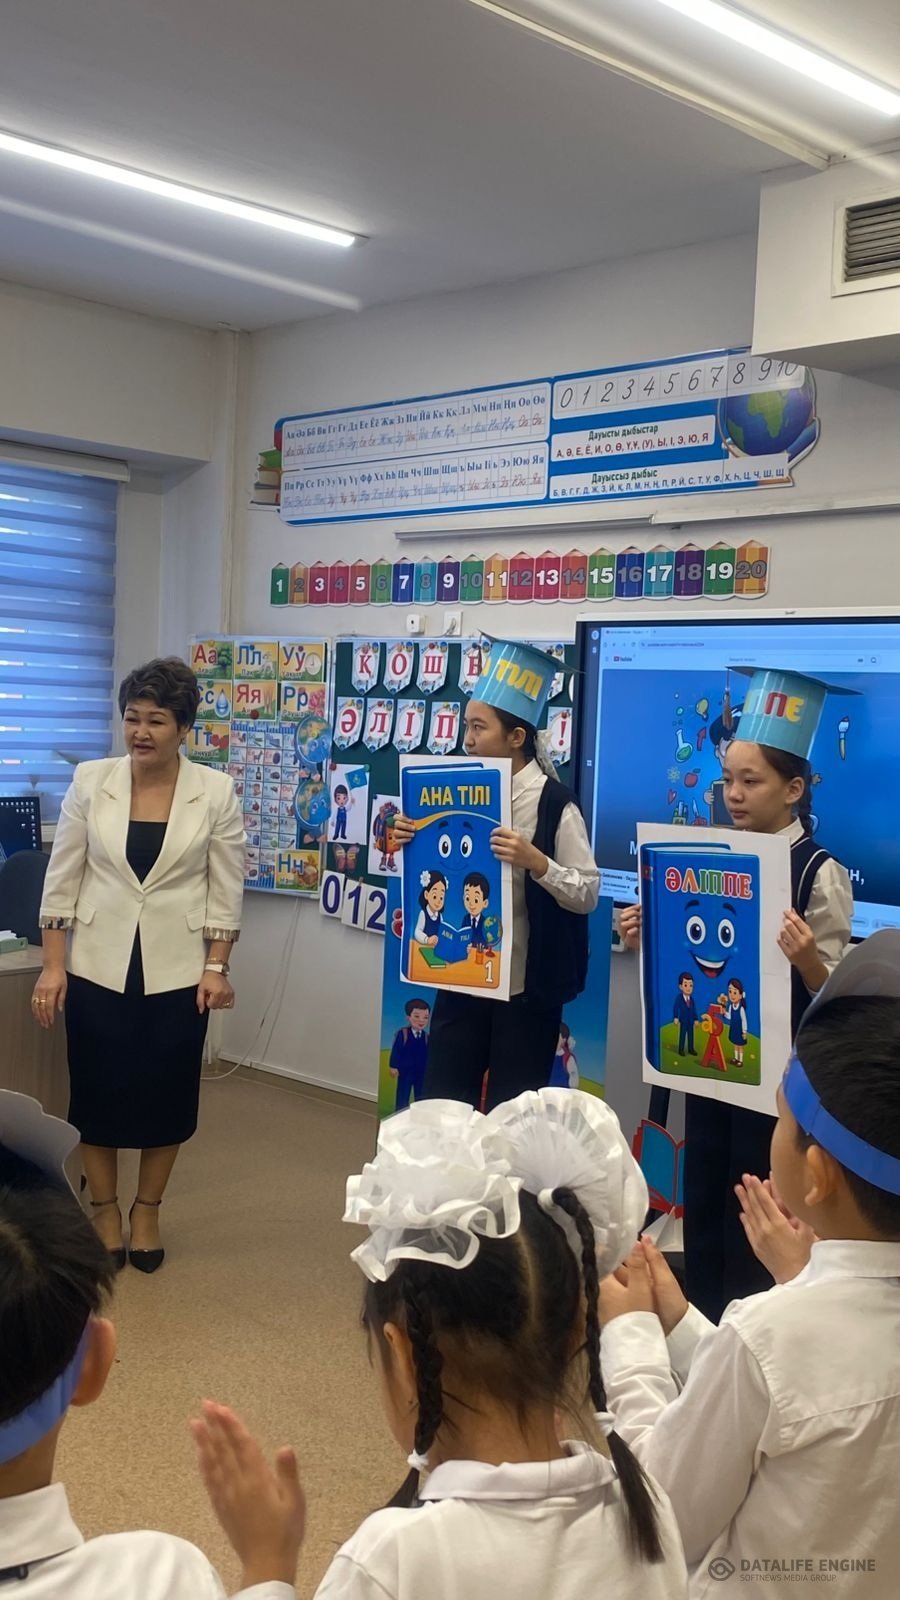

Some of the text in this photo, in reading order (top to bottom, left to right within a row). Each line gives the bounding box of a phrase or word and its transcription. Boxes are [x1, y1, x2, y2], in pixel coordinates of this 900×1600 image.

[560, 358, 798, 408] 0 1 2 3 4 5 6 7 8 9 10
[473, 404, 487, 413] Мм
[518, 397, 531, 407] Оо
[589, 425, 658, 441] Дауысты дыбыстар
[702, 433, 709, 441] Я
[360, 474, 372, 484] Фф
[513, 457, 530, 467] Юю
[532, 455, 544, 464] Яя
[591, 469, 658, 484] Дауыссыз дыбыс
[277, 560, 767, 592] 1 2 3 4 5 6 7 8 9 10 11 12 13 14 15 16 17 18 19 20
[194, 644, 217, 664] Аа
[237, 645, 261, 665] Лл
[283, 646, 306, 671] Уу
[359, 653, 442, 677] ҚОШ
[236, 684, 261, 703] Яя
[284, 686, 308, 711] Рр
[193, 726, 212, 746] Тт
[419, 785, 491, 806] АНА ТІЛІ
[279, 854, 304, 873] Нн
[665, 866, 753, 900] ӘЛІППЕ
[322, 875, 387, 932] 0 1 2
[485, 960, 494, 983] 1
